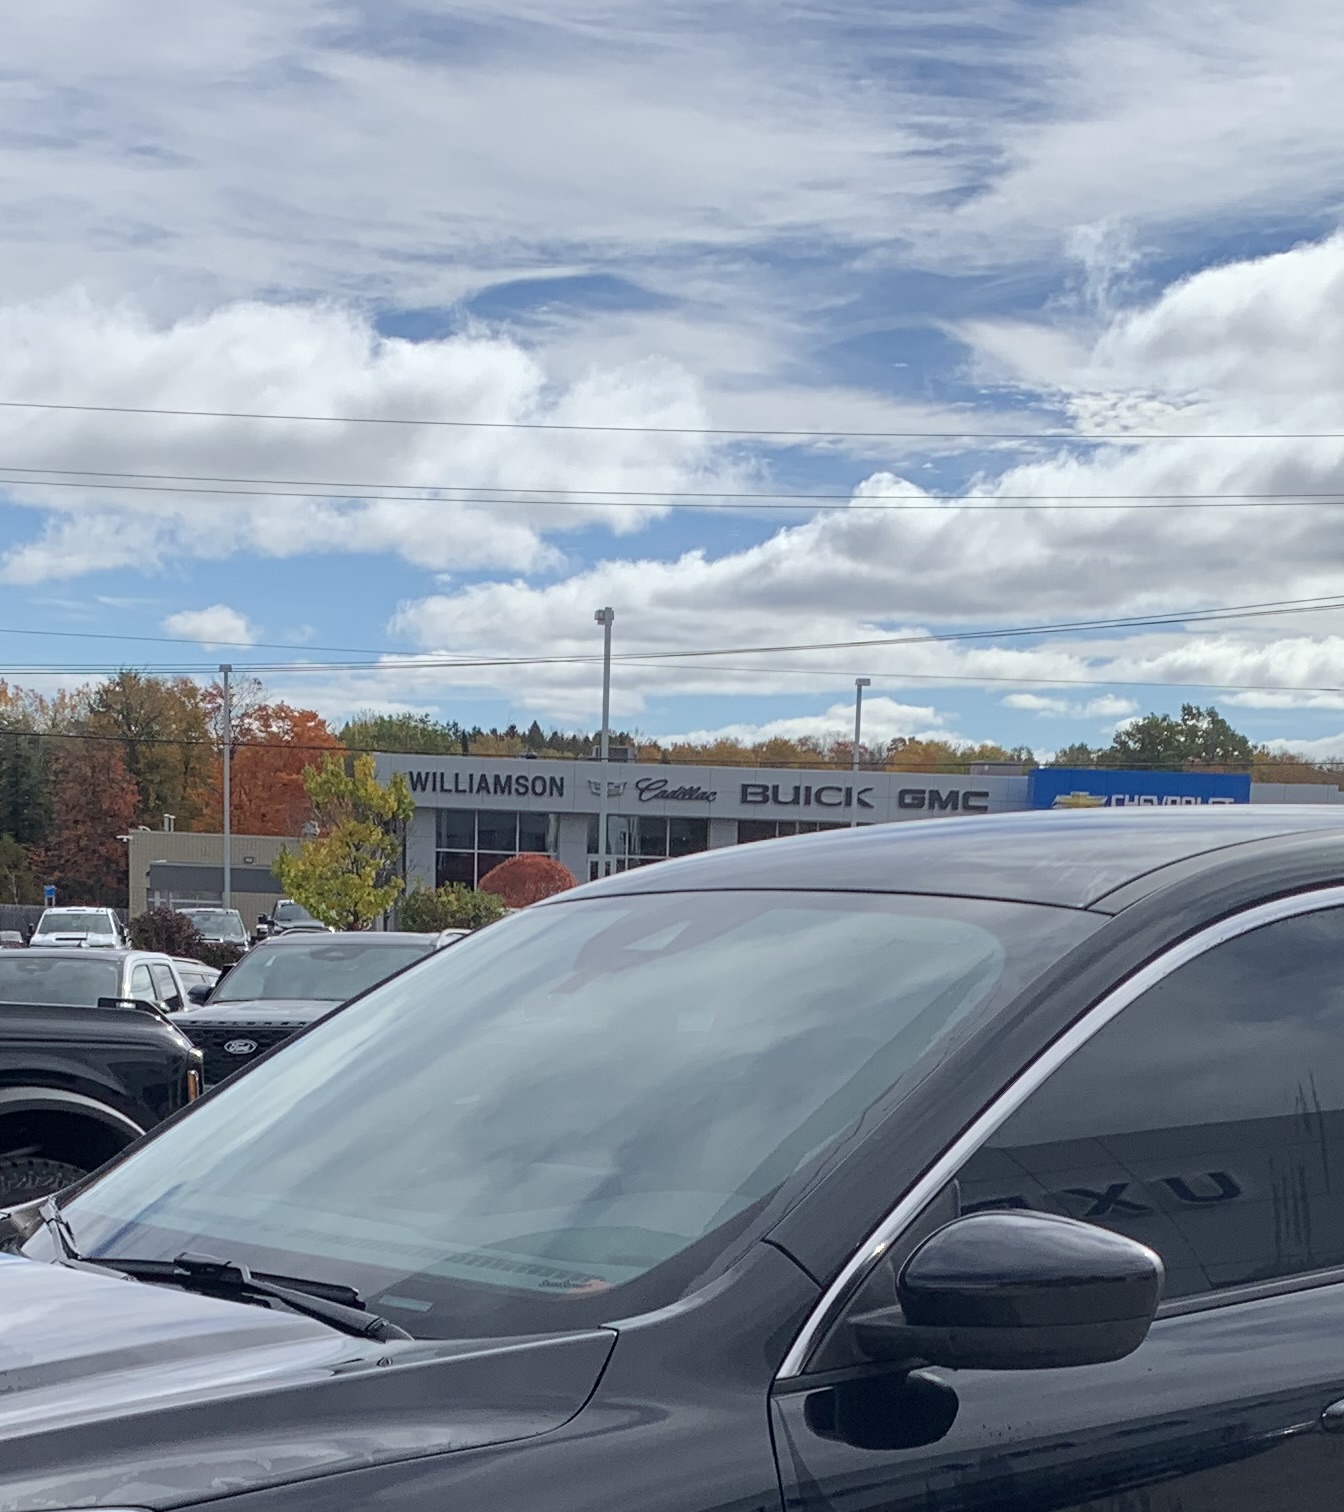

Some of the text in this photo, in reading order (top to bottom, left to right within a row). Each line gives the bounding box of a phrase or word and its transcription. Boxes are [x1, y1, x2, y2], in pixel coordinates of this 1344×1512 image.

[409, 770, 565, 798] WILLIAMSON
[636, 777, 718, 802] Cadillac
[741, 783, 875, 809] BUICK
[898, 789, 990, 812] GMC
